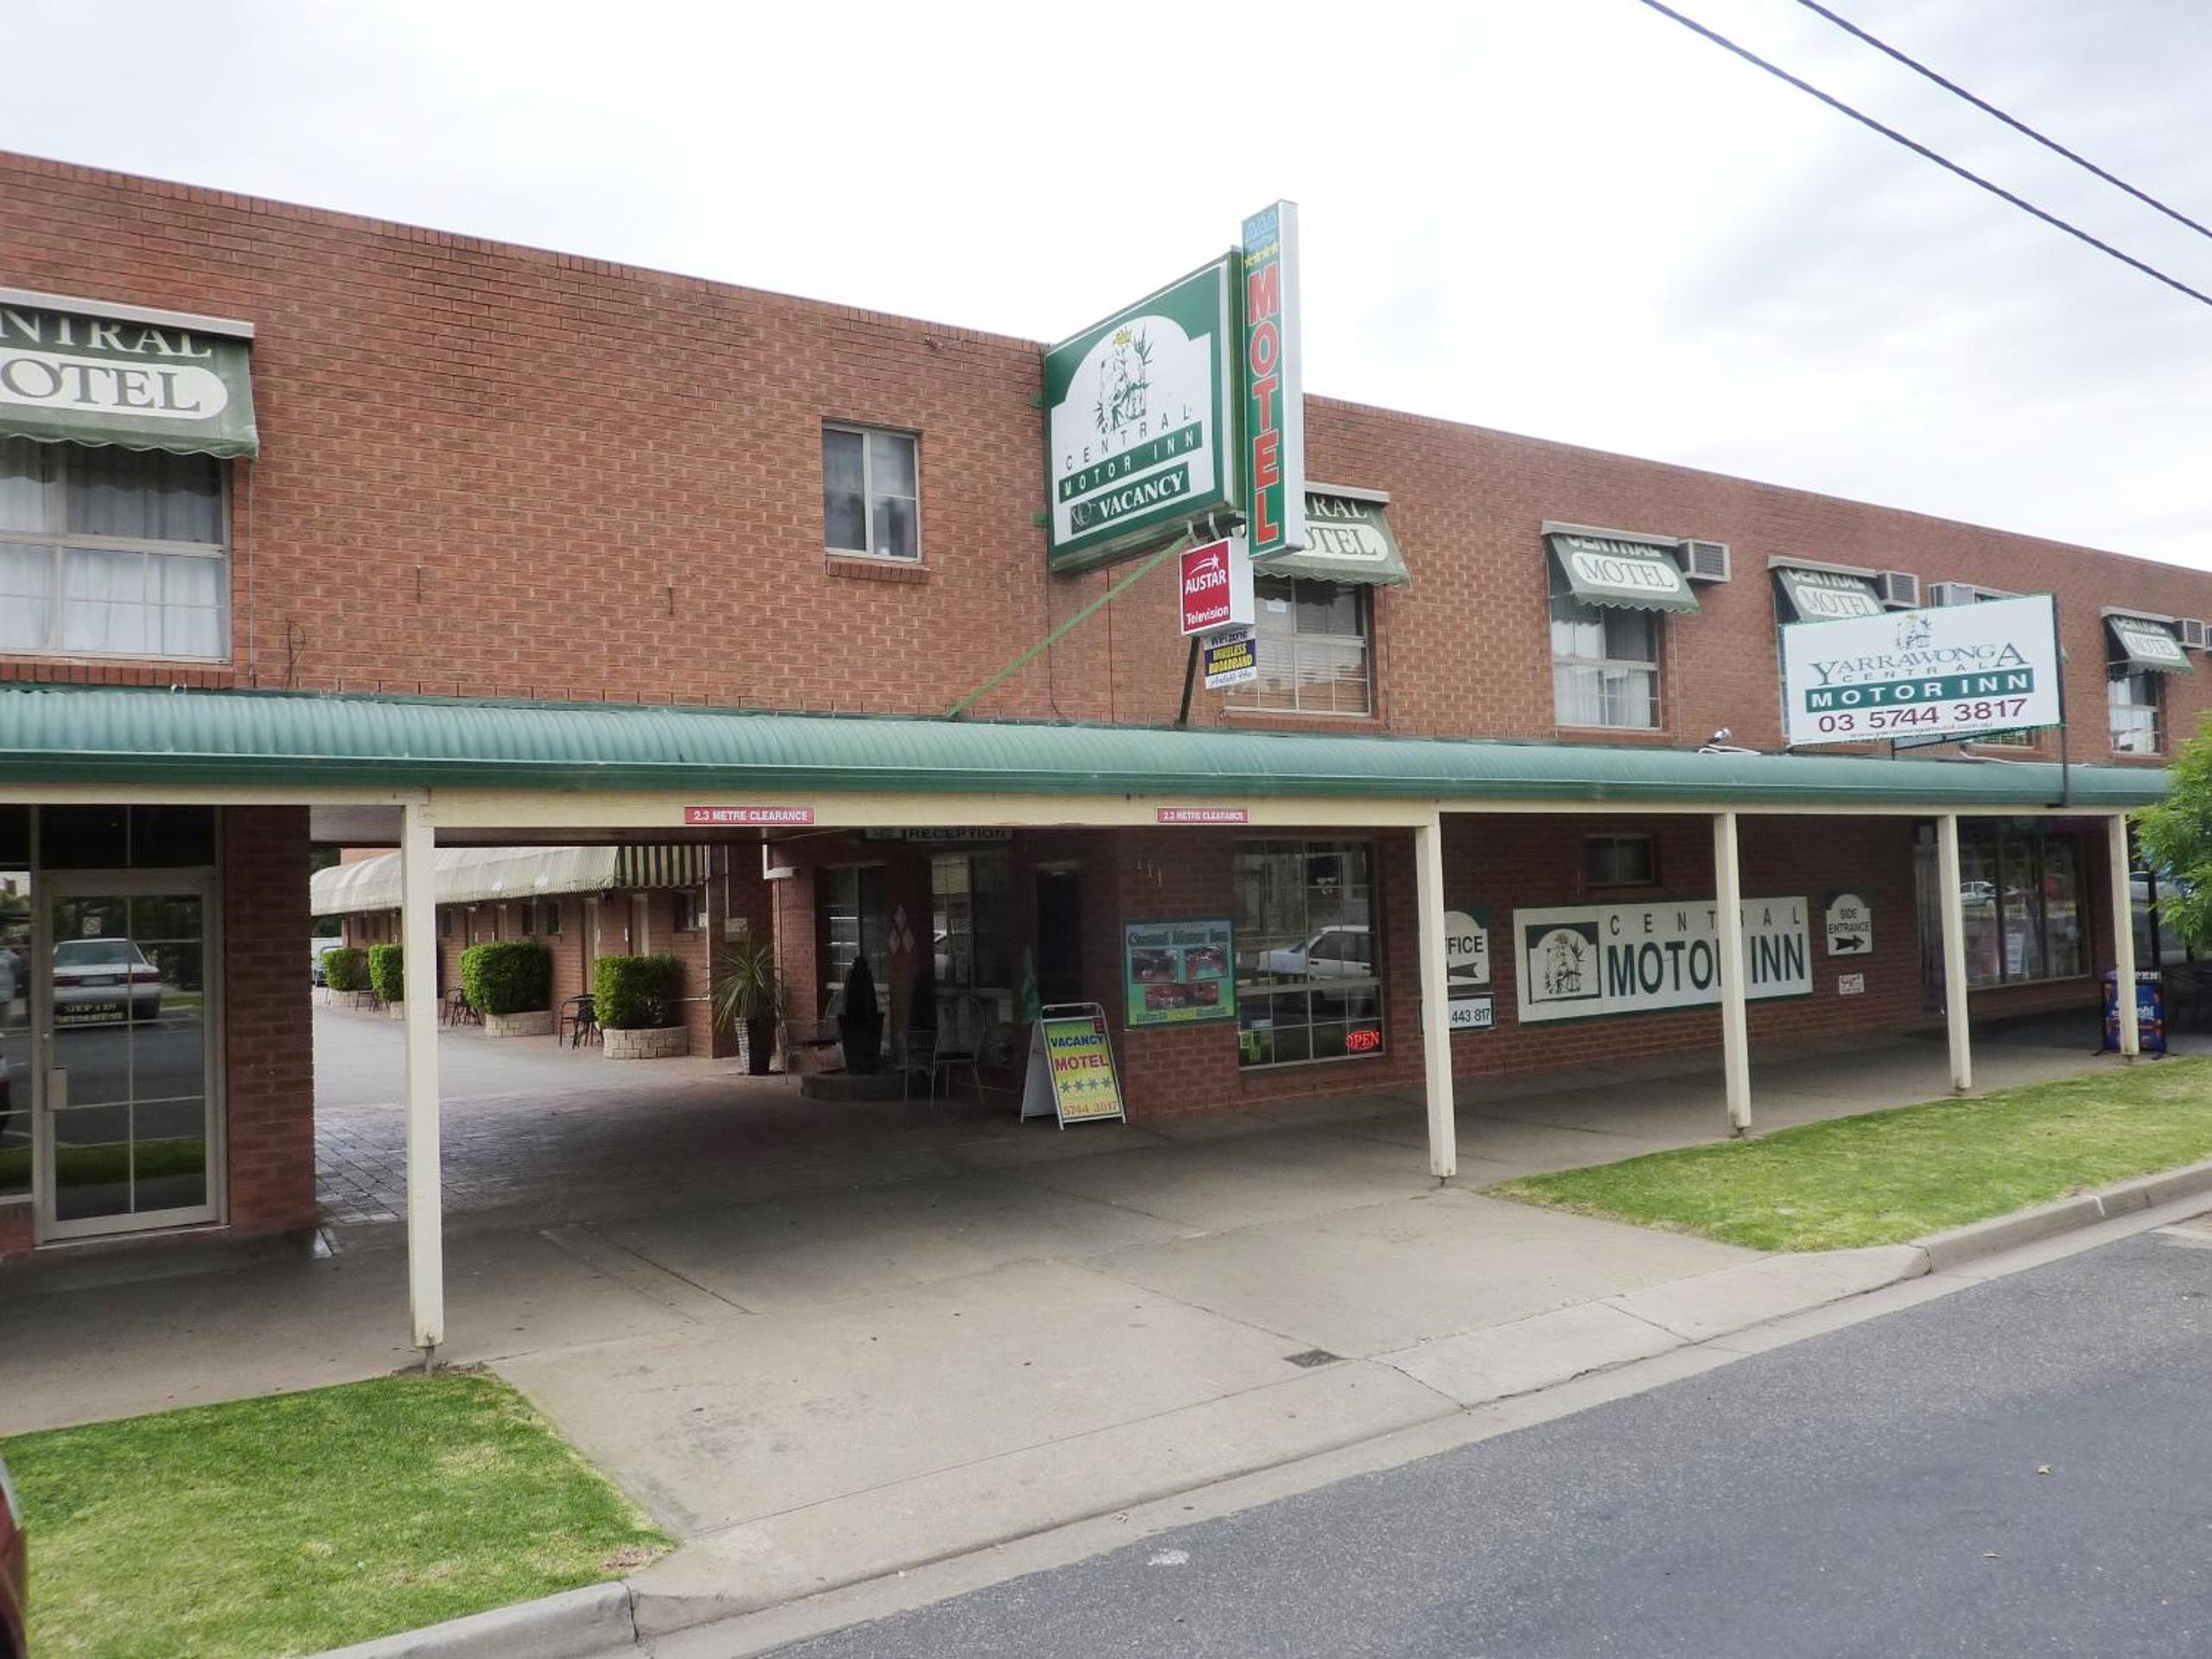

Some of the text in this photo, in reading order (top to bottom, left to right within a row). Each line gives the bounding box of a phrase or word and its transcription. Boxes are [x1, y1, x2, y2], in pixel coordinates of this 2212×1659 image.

[1248, 263, 1280, 544] MOTEL
[1065, 404, 1192, 471] CENTRAL
[1065, 430, 1193, 497] MOTOR INN
[1099, 471, 1184, 518] VACANCY
[1305, 496, 1368, 518] RAL
[1185, 569, 1227, 595] AUSTAR
[1579, 556, 1675, 588] MOTEL
[1186, 605, 1229, 626] Television
[1809, 643, 2030, 686] YARRAWONGA
[1843, 663, 1988, 683] CENTRAL
[1812, 674, 2027, 708] MOTOR INN
[1819, 698, 2027, 733] 03 5744 3817
[694, 810, 808, 821] 2.3 METRE CLEARANCE
[909, 827, 1006, 839] RECEPTION
[1610, 906, 1801, 936] CENTAL
[1828, 921, 1871, 934] ENTRANCE
[1446, 936, 1484, 955] FICE
[1607, 932, 1805, 997] MOTO INN
[1050, 1035, 1103, 1048] VACANCY
[1346, 1030, 1380, 1051] OPEN
[1054, 1055, 1109, 1071] MOTEL
